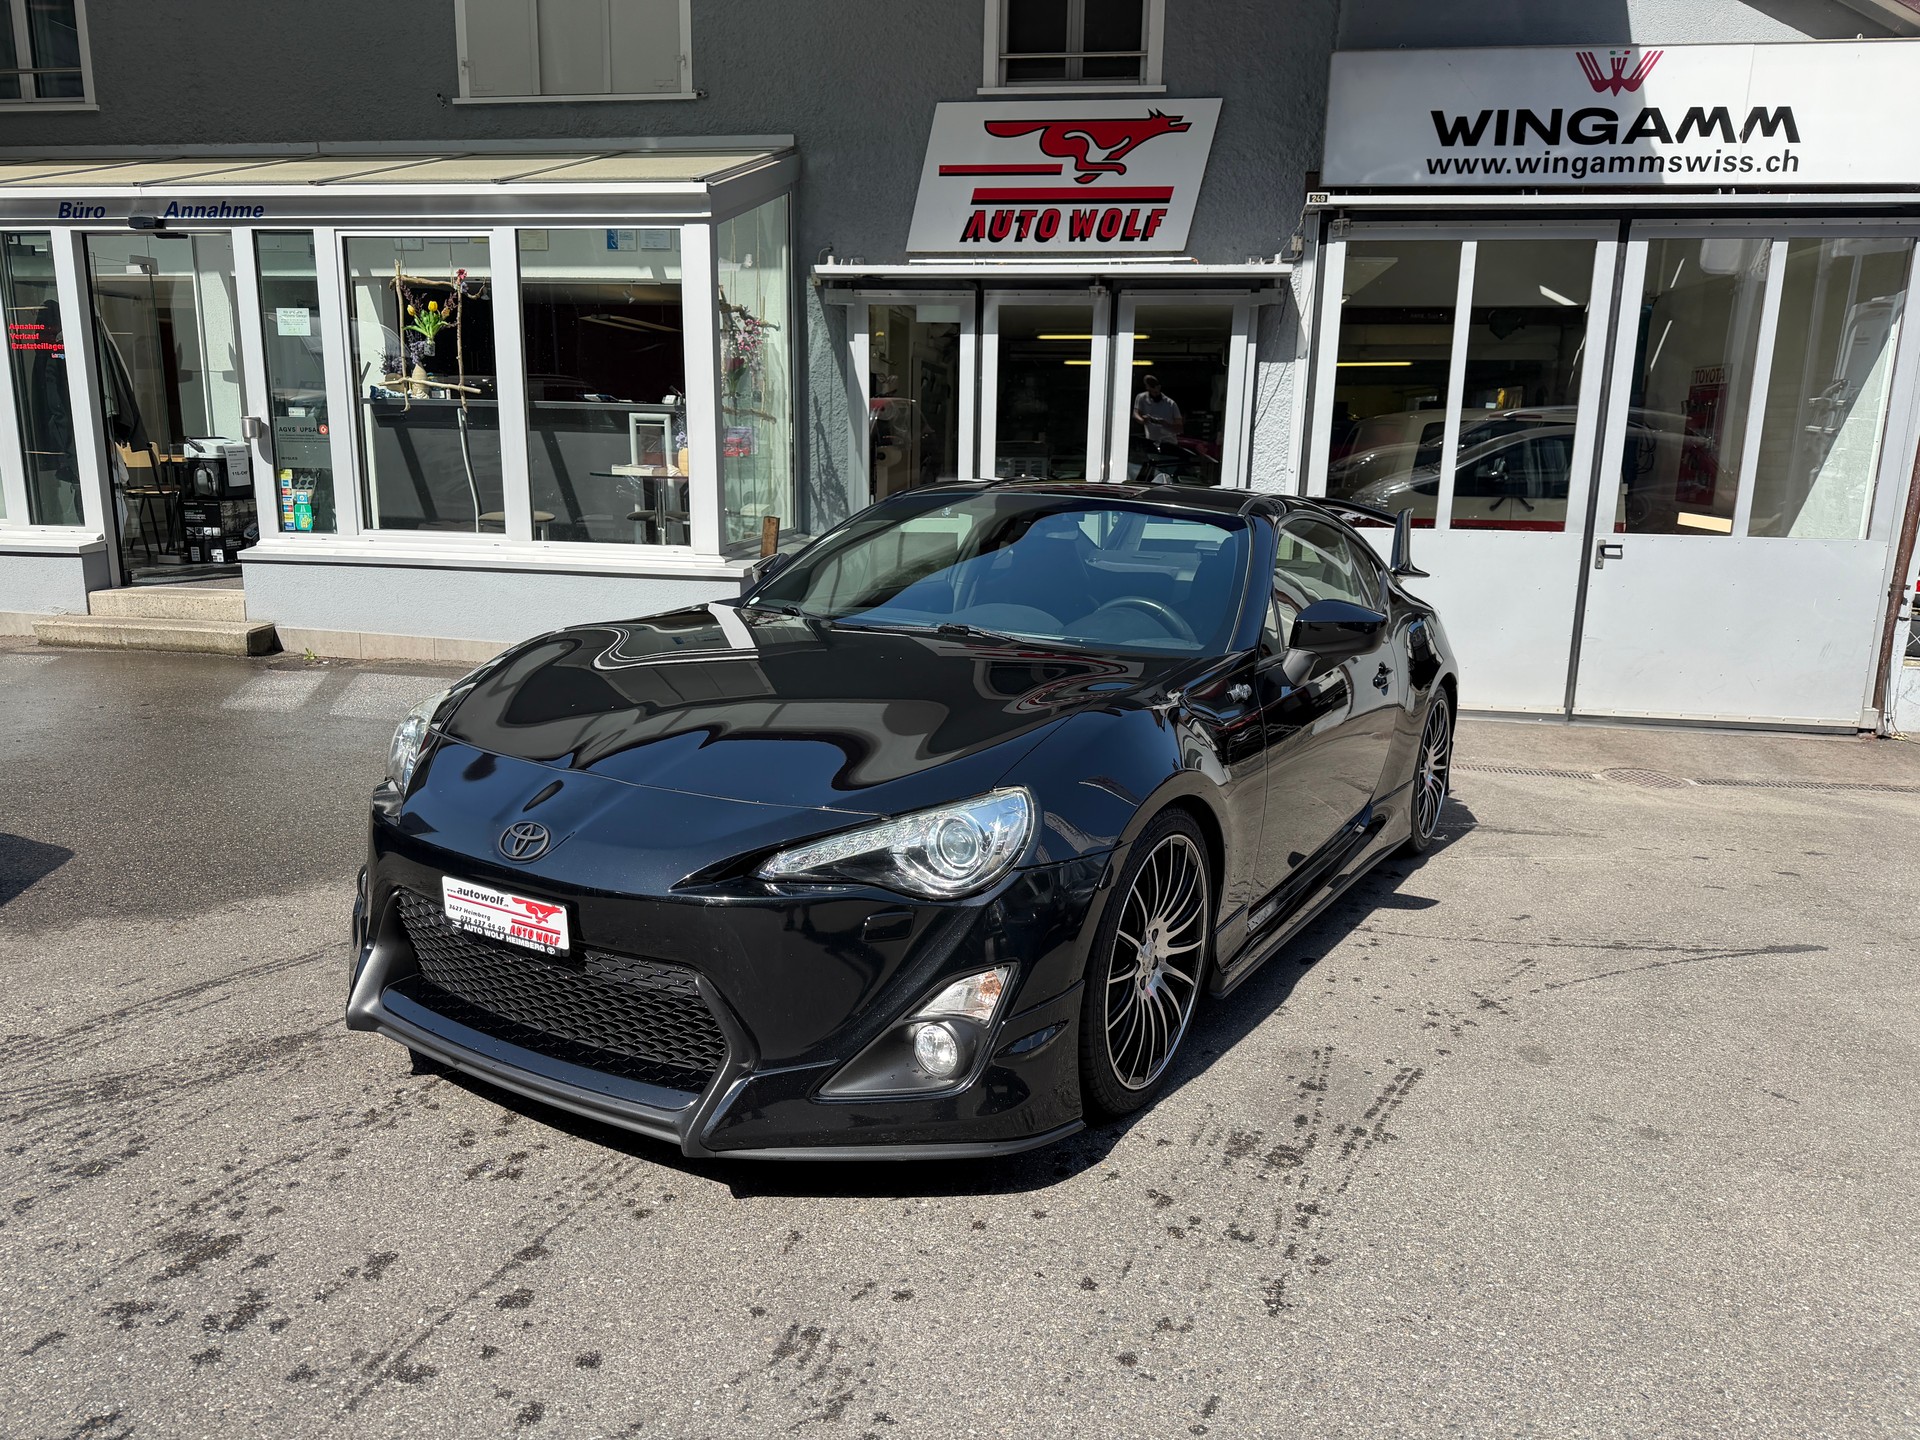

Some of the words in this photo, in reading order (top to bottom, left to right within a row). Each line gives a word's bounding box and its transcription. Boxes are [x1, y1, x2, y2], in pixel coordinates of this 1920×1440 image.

[1430, 106, 1801, 147] WINGAMM
[1426, 148, 1800, 179] www.wingammswiss.ch
[1311, 195, 1326, 203] 249
[58, 202, 106, 219] Büro
[163, 201, 265, 218] Annahme
[959, 209, 1061, 243] AUTO
[1069, 208, 1168, 242] WOLF
[1695, 368, 1725, 384] TOYOTA
[460, 915, 472, 923] 033
[463, 908, 491, 921] Heimberg
[463, 924, 483, 934] AUTO
[484, 929, 505, 941] WOLF
[506, 935, 546, 952] HEIMBERG
[510, 925, 534, 939] AUTO
[536, 932, 560, 946] WOLF
